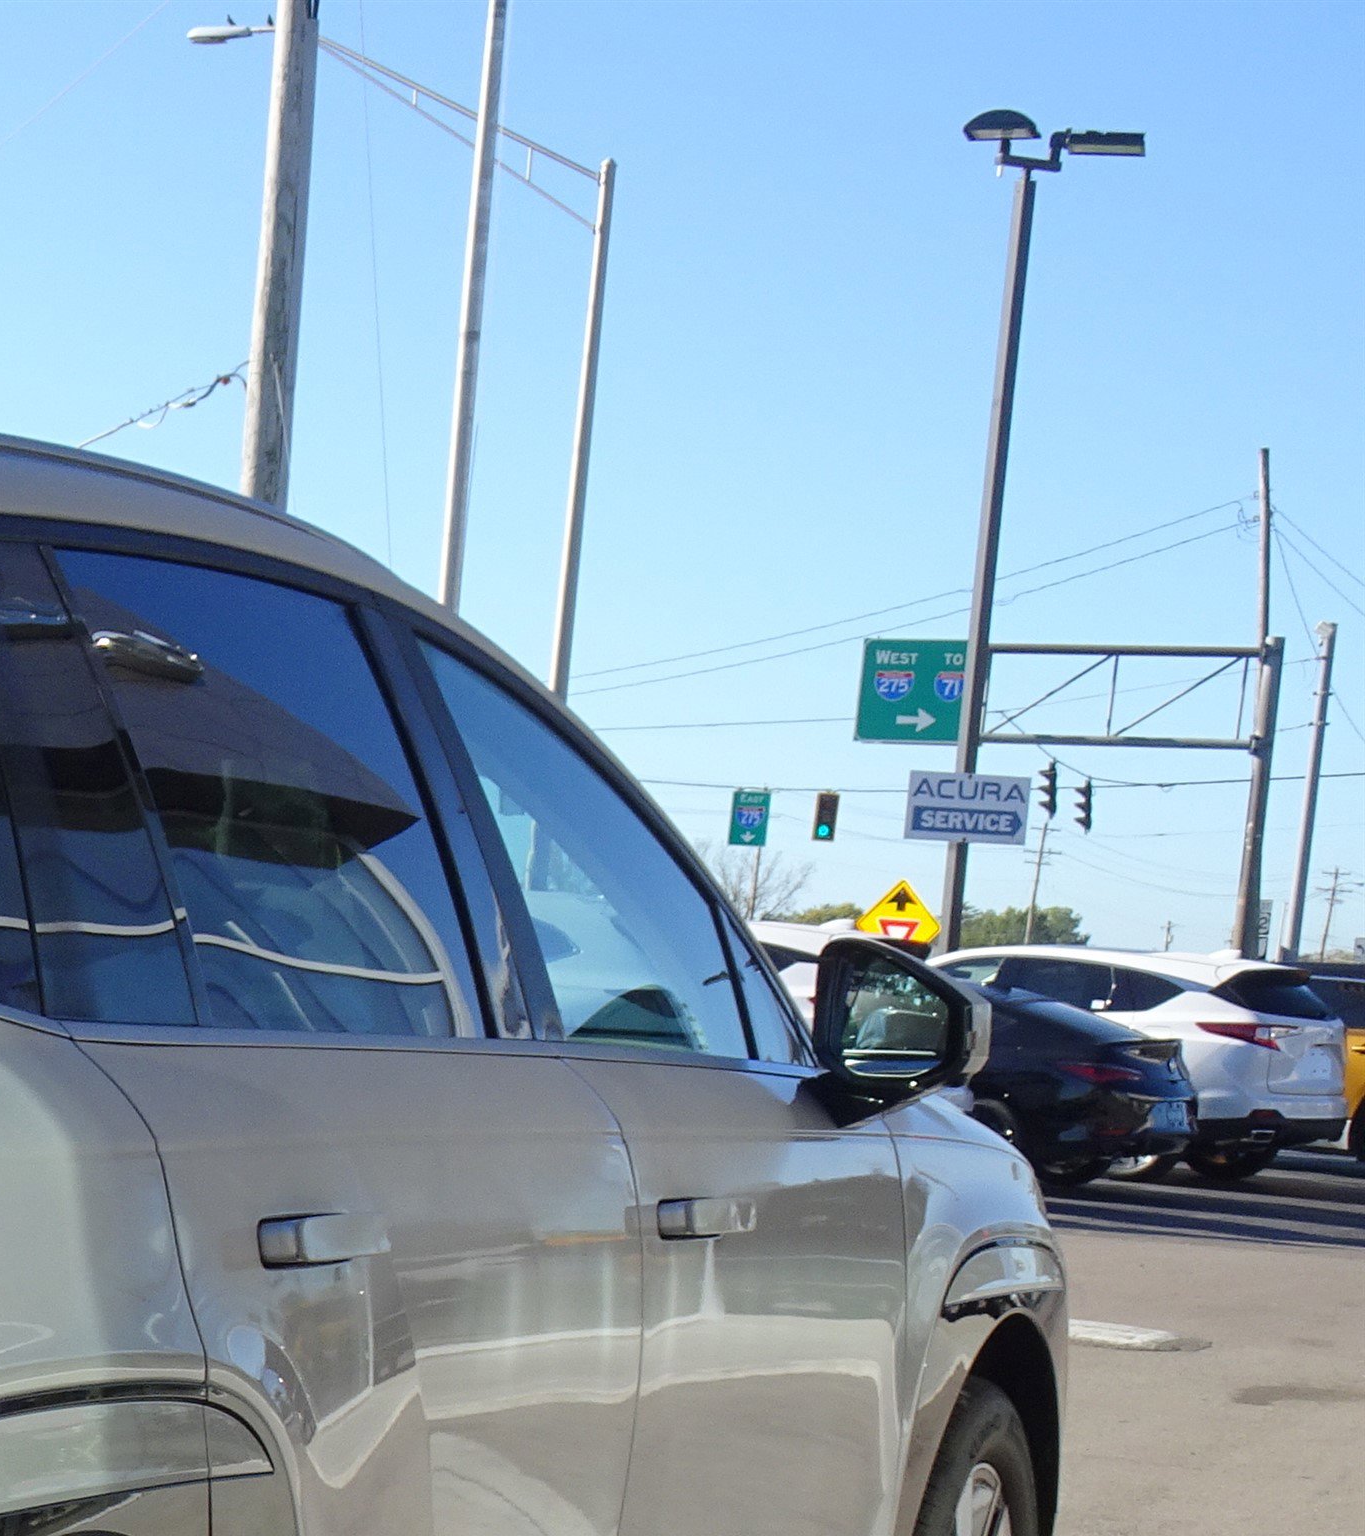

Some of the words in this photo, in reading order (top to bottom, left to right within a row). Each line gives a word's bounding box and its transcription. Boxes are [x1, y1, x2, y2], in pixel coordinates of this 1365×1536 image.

[875, 650, 919, 666] WEST
[943, 652, 964, 666] TO
[878, 678, 909, 694] 275
[942, 679, 962, 697] 71
[912, 777, 1027, 803] ACURA
[919, 809, 1015, 832] SERVICE
